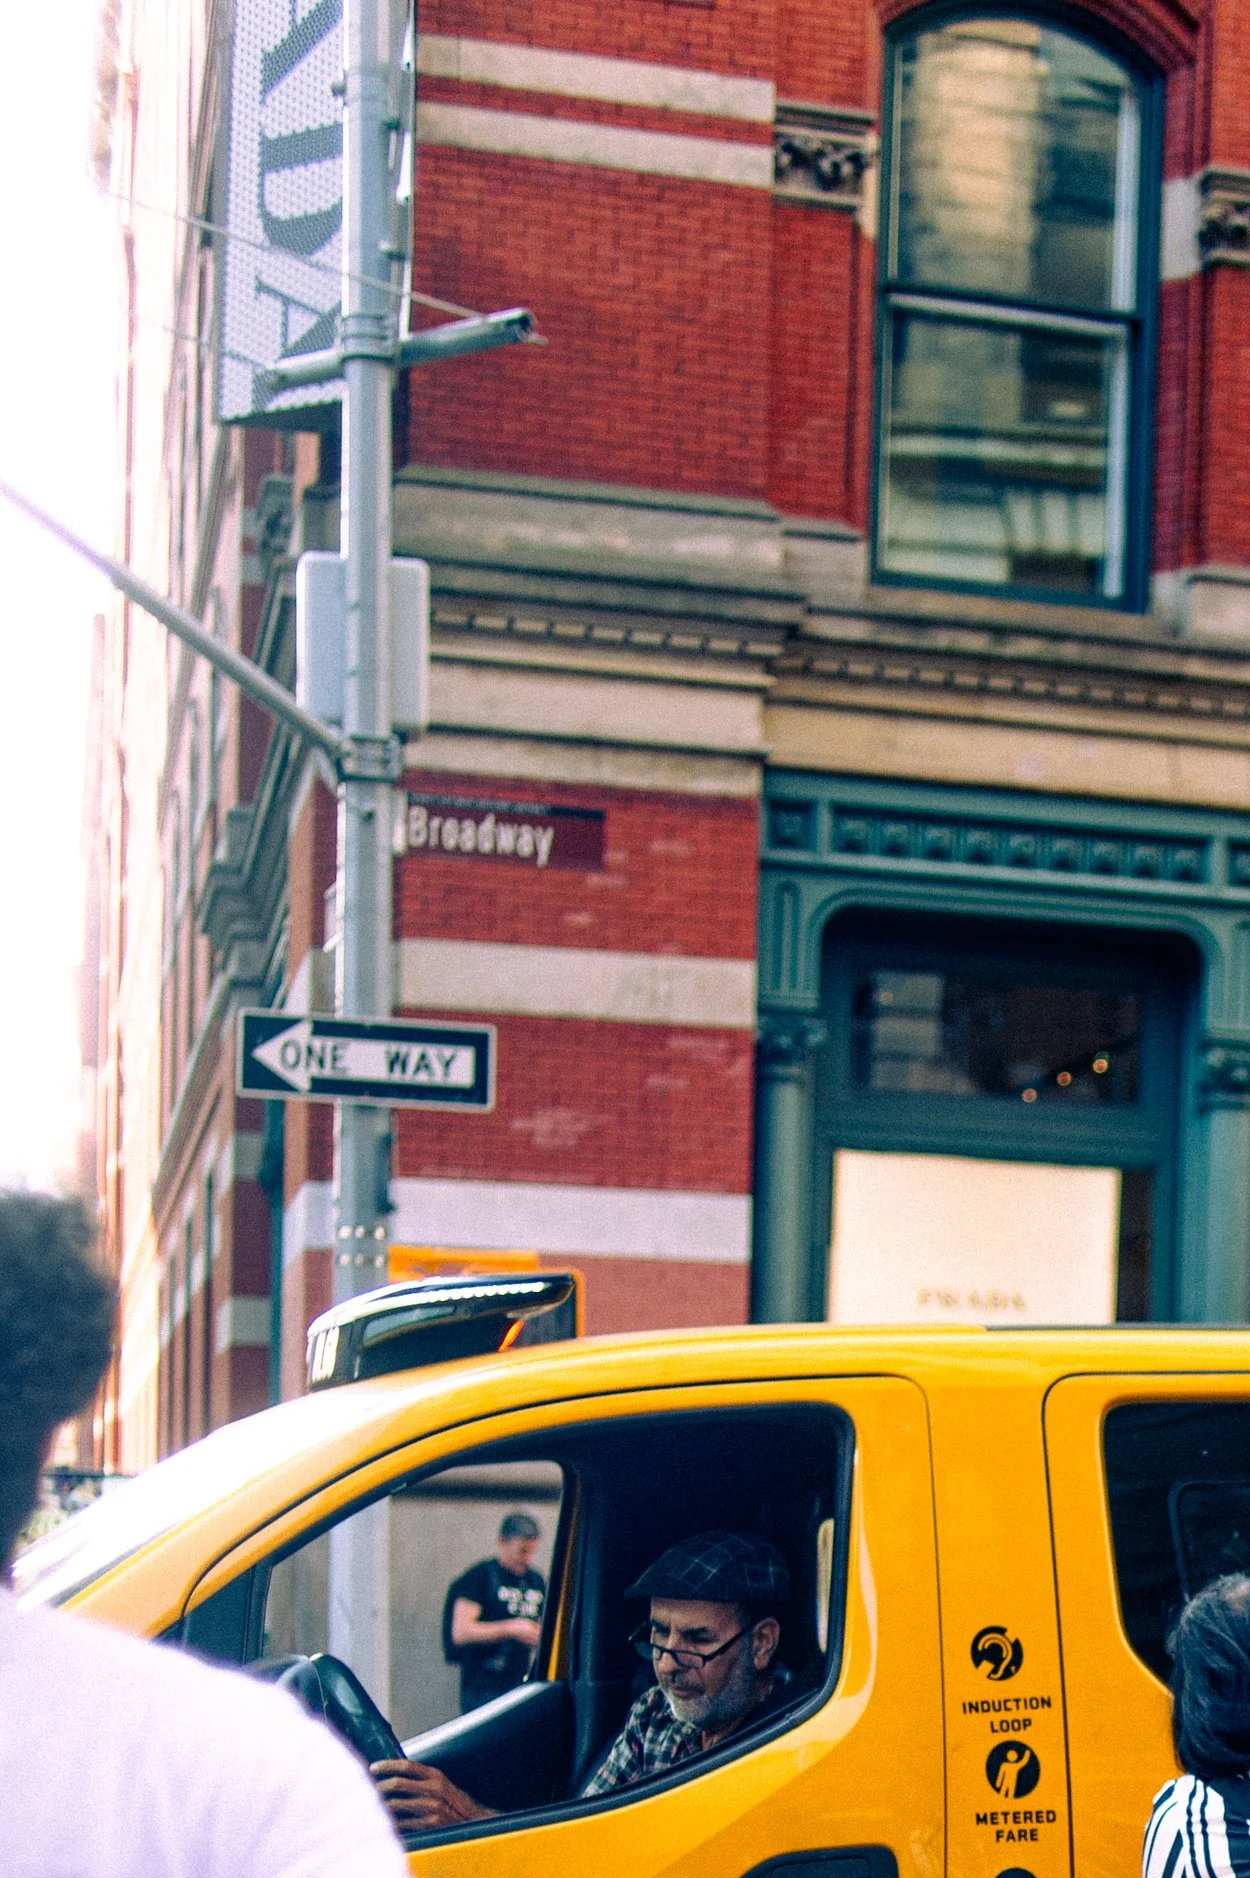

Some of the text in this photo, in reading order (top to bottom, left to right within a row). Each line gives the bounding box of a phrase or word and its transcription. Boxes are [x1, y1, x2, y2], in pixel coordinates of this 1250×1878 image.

[408, 805, 554, 868] Broadway
[279, 1039, 457, 1080] ONE WAY
[962, 1696, 1053, 1714] INDUCTION
[990, 1718, 1033, 1734] LOOP
[975, 1810, 1058, 1826] METERED
[995, 1828, 1039, 1843] FARE
